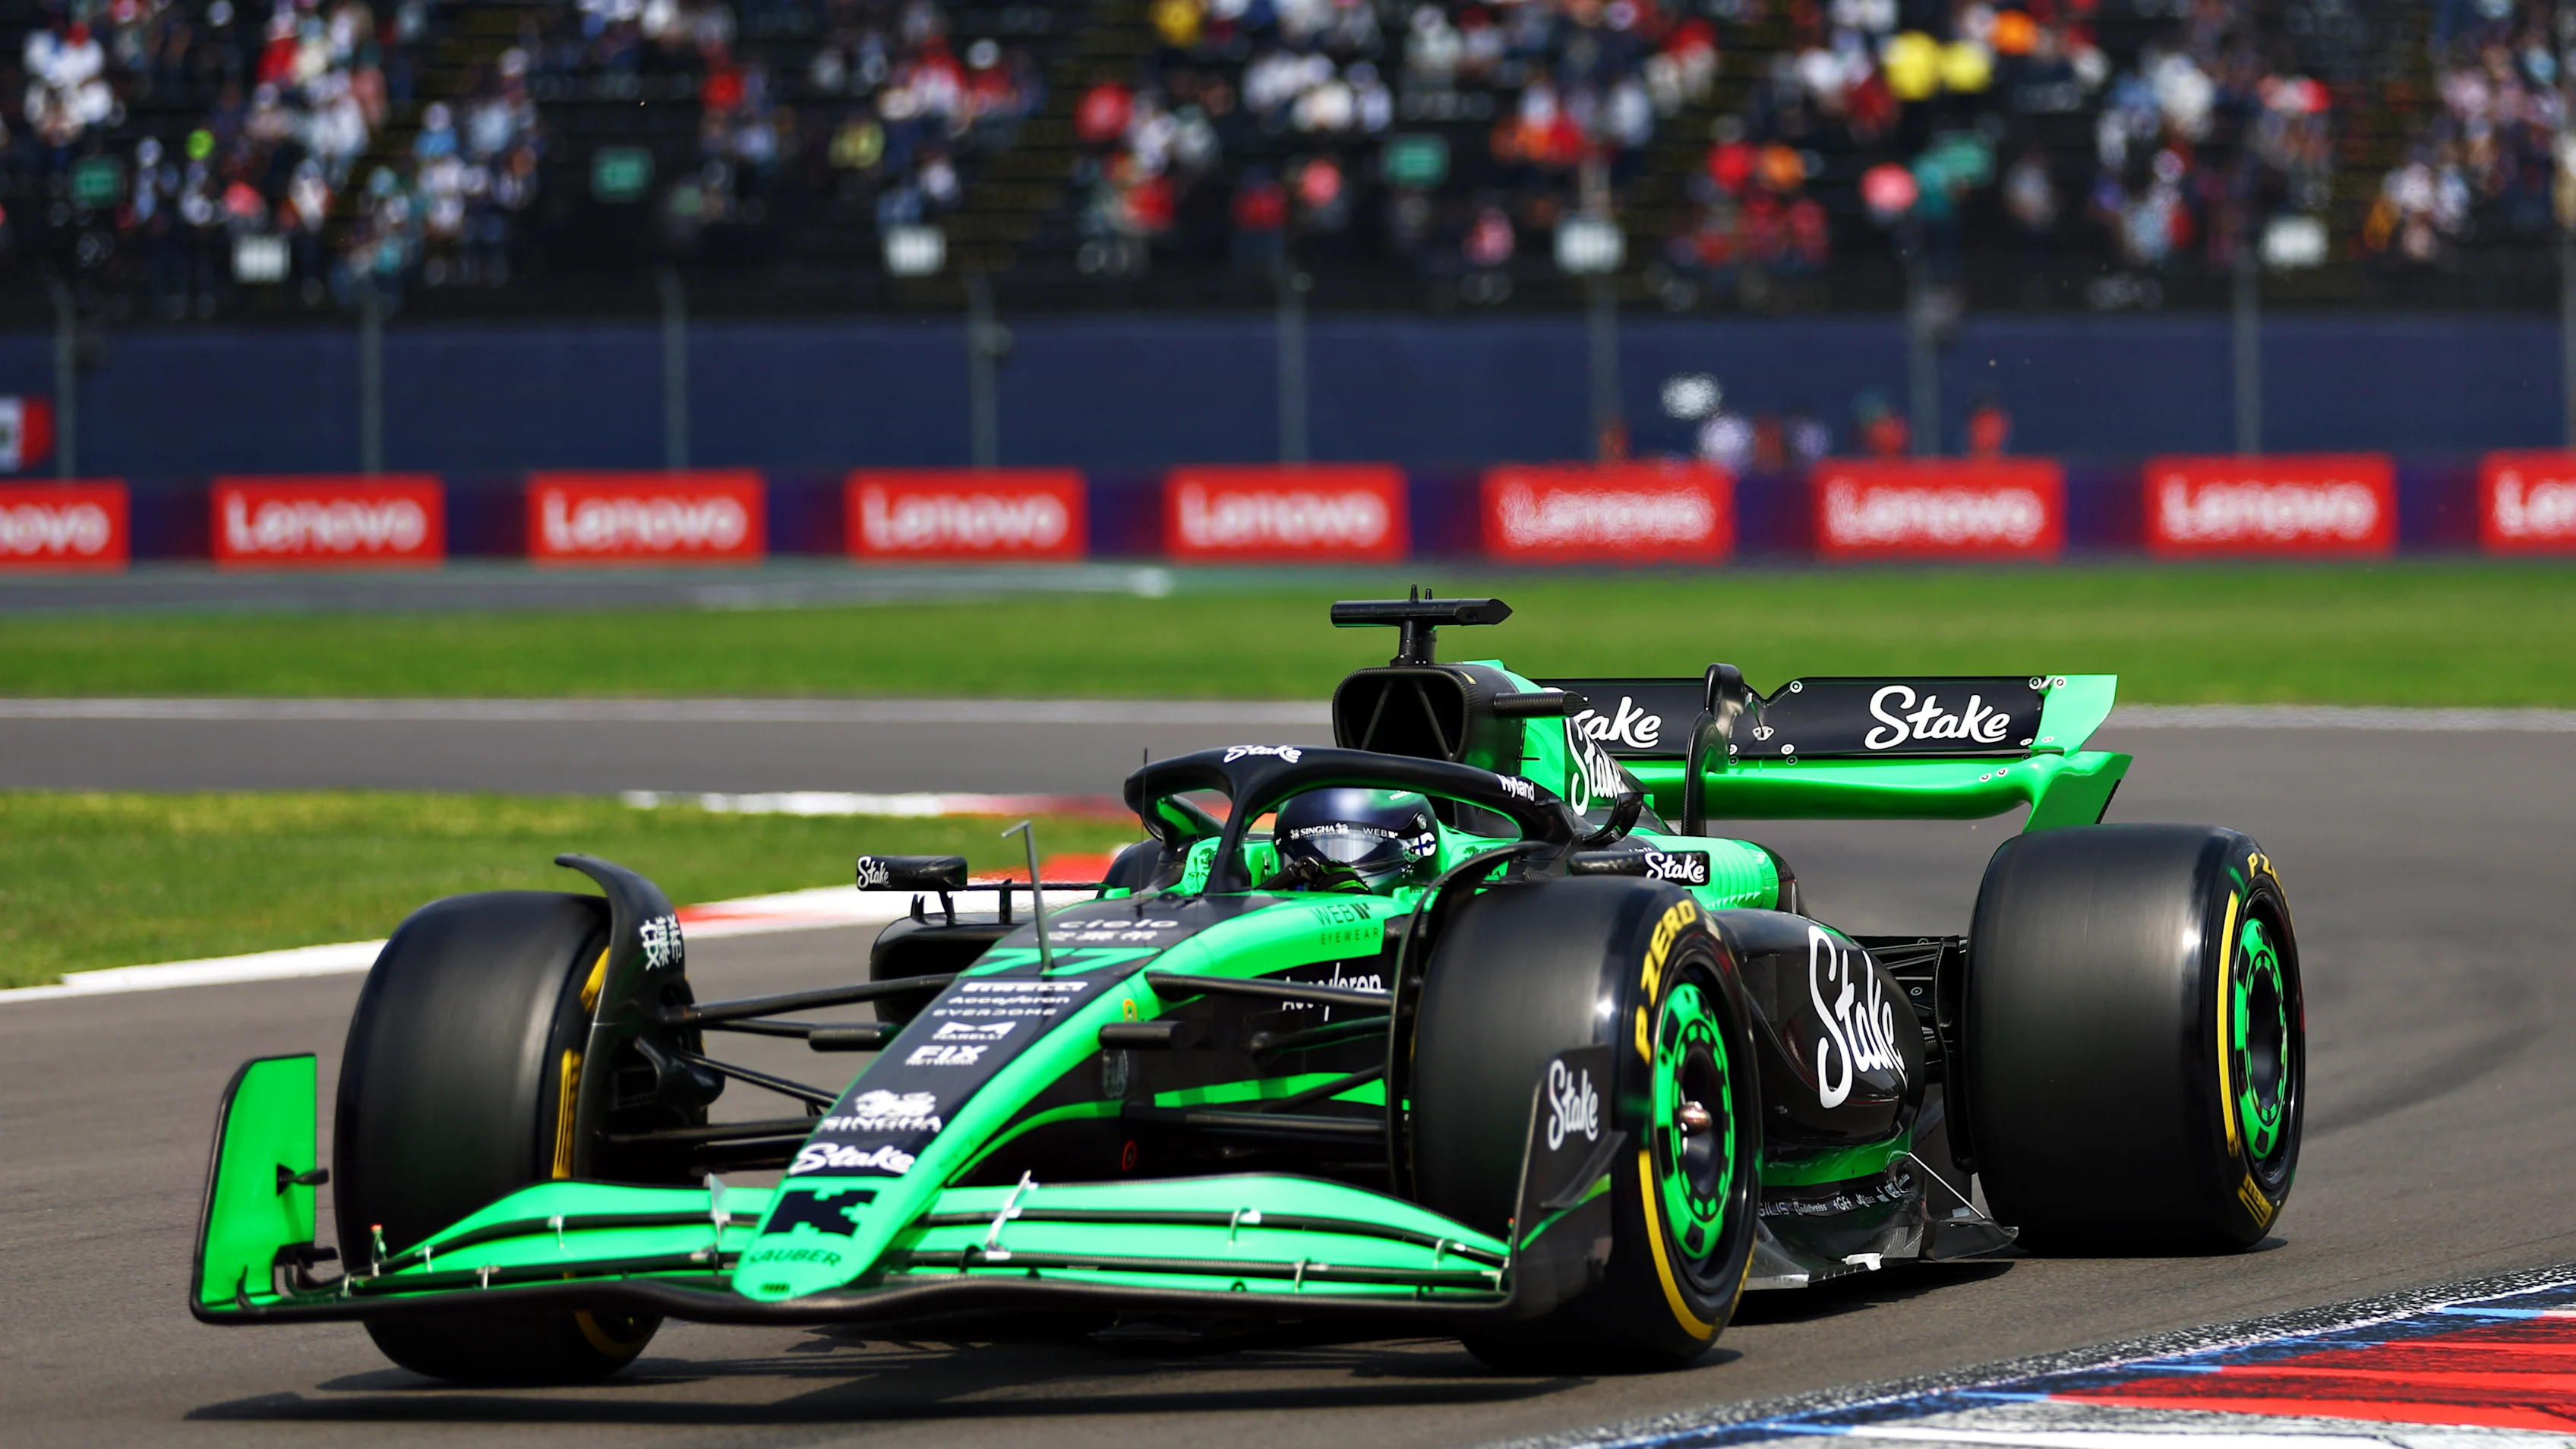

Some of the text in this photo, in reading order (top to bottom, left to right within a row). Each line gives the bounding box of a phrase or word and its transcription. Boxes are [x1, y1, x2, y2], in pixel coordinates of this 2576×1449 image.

[226, 492, 427, 552] Lenovo
[543, 488, 748, 552] Lenovo
[862, 486, 1069, 549] Lenovo
[1179, 484, 1390, 548] Lenovo
[1542, 687, 1662, 748] ake
[1864, 685, 2011, 750] Stake
[1223, 745, 1302, 763] Stake
[1496, 773, 1535, 802] Hyland
[1300, 825, 1335, 836] SINGHA
[1362, 827, 1388, 838] WEB
[857, 856, 891, 887] Stake
[1645, 852, 1705, 883] Stake
[1309, 903, 1355, 927] WEB
[1321, 927, 1379, 945] EYEWEAR
[954, 947, 1163, 977] 77
[1635, 898, 1698, 1066] P ZERO
[948, 995, 1070, 1006] Accelleron
[1808, 925, 1908, 1109] Stake
[910, 1044, 990, 1062] FIX
[1548, 1059, 1599, 1151] Stake
[788, 1142, 916, 1176] Stake
